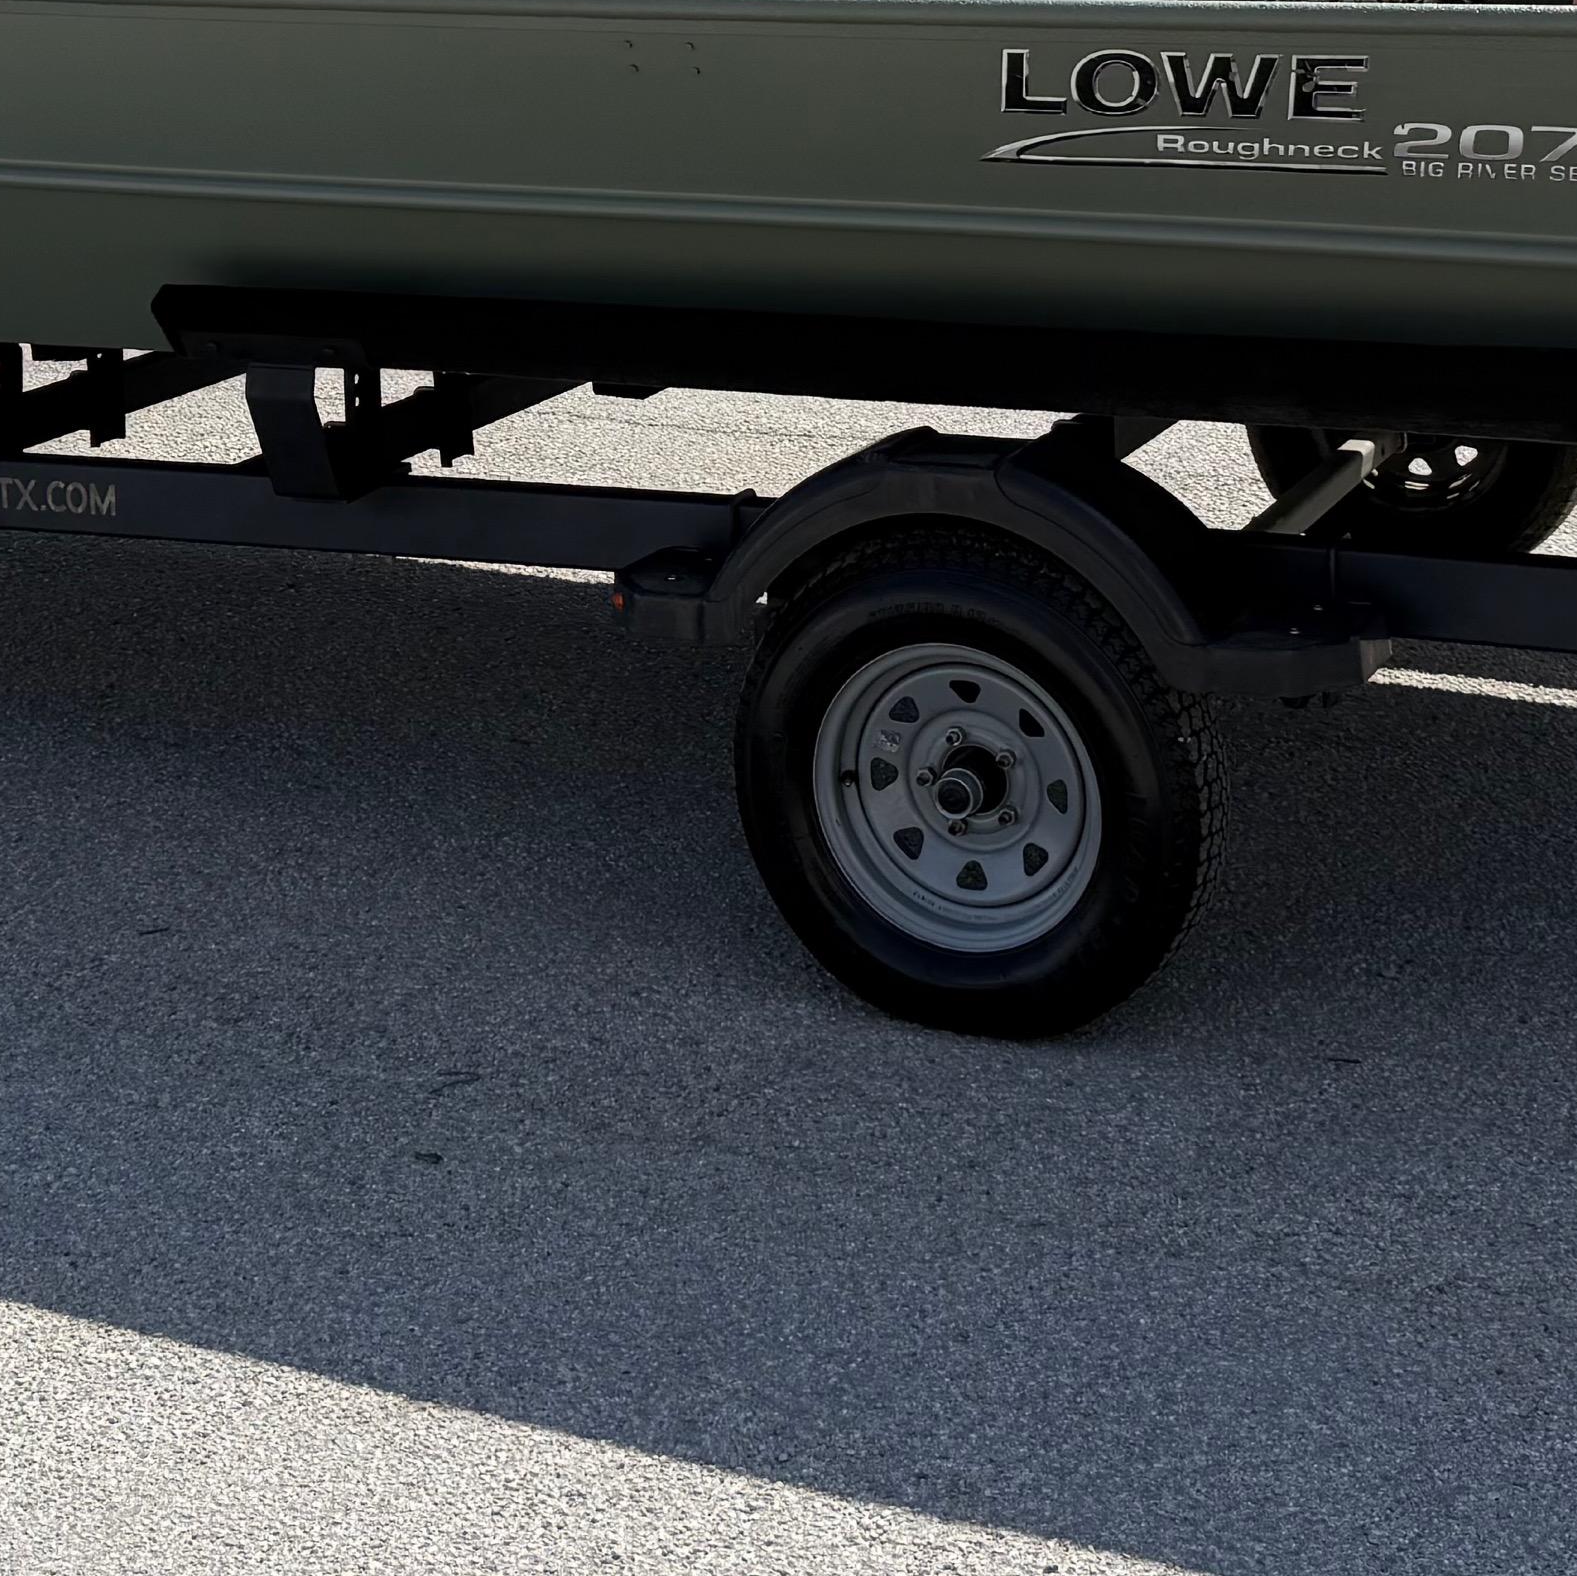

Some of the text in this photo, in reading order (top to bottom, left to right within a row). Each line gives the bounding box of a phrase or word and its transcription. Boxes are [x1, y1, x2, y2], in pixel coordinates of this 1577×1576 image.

[1000, 48, 1370, 122] LOWE
[1156, 134, 1384, 161] Roughneck
[1402, 160, 1445, 178] BIG
